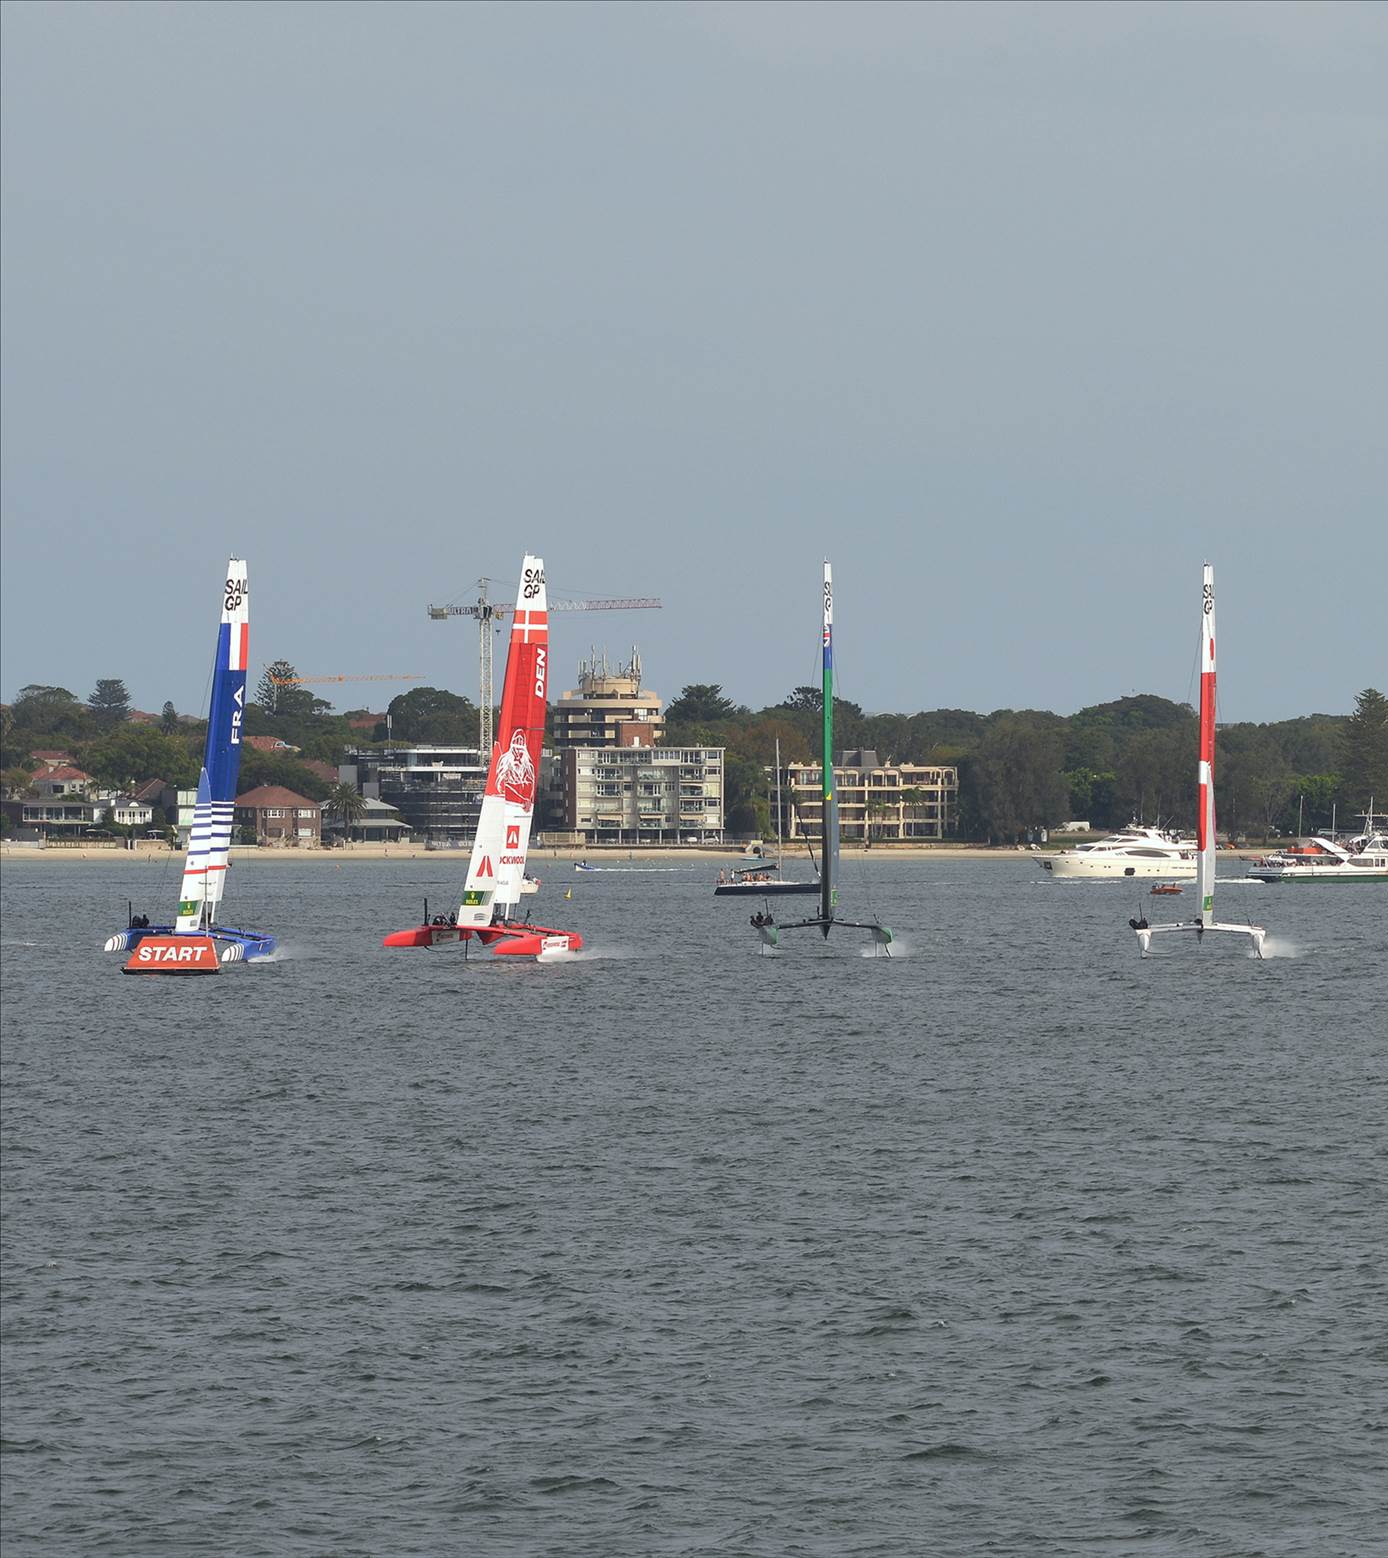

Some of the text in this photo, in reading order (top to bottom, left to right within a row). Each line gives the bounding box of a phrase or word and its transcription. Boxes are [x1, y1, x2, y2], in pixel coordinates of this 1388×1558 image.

[225, 579, 249, 595] SAIL
[524, 584, 540, 599] GP
[225, 596, 242, 611] GP
[534, 648, 546, 698] DEN
[231, 685, 244, 744] FRA
[138, 946, 207, 962] START
